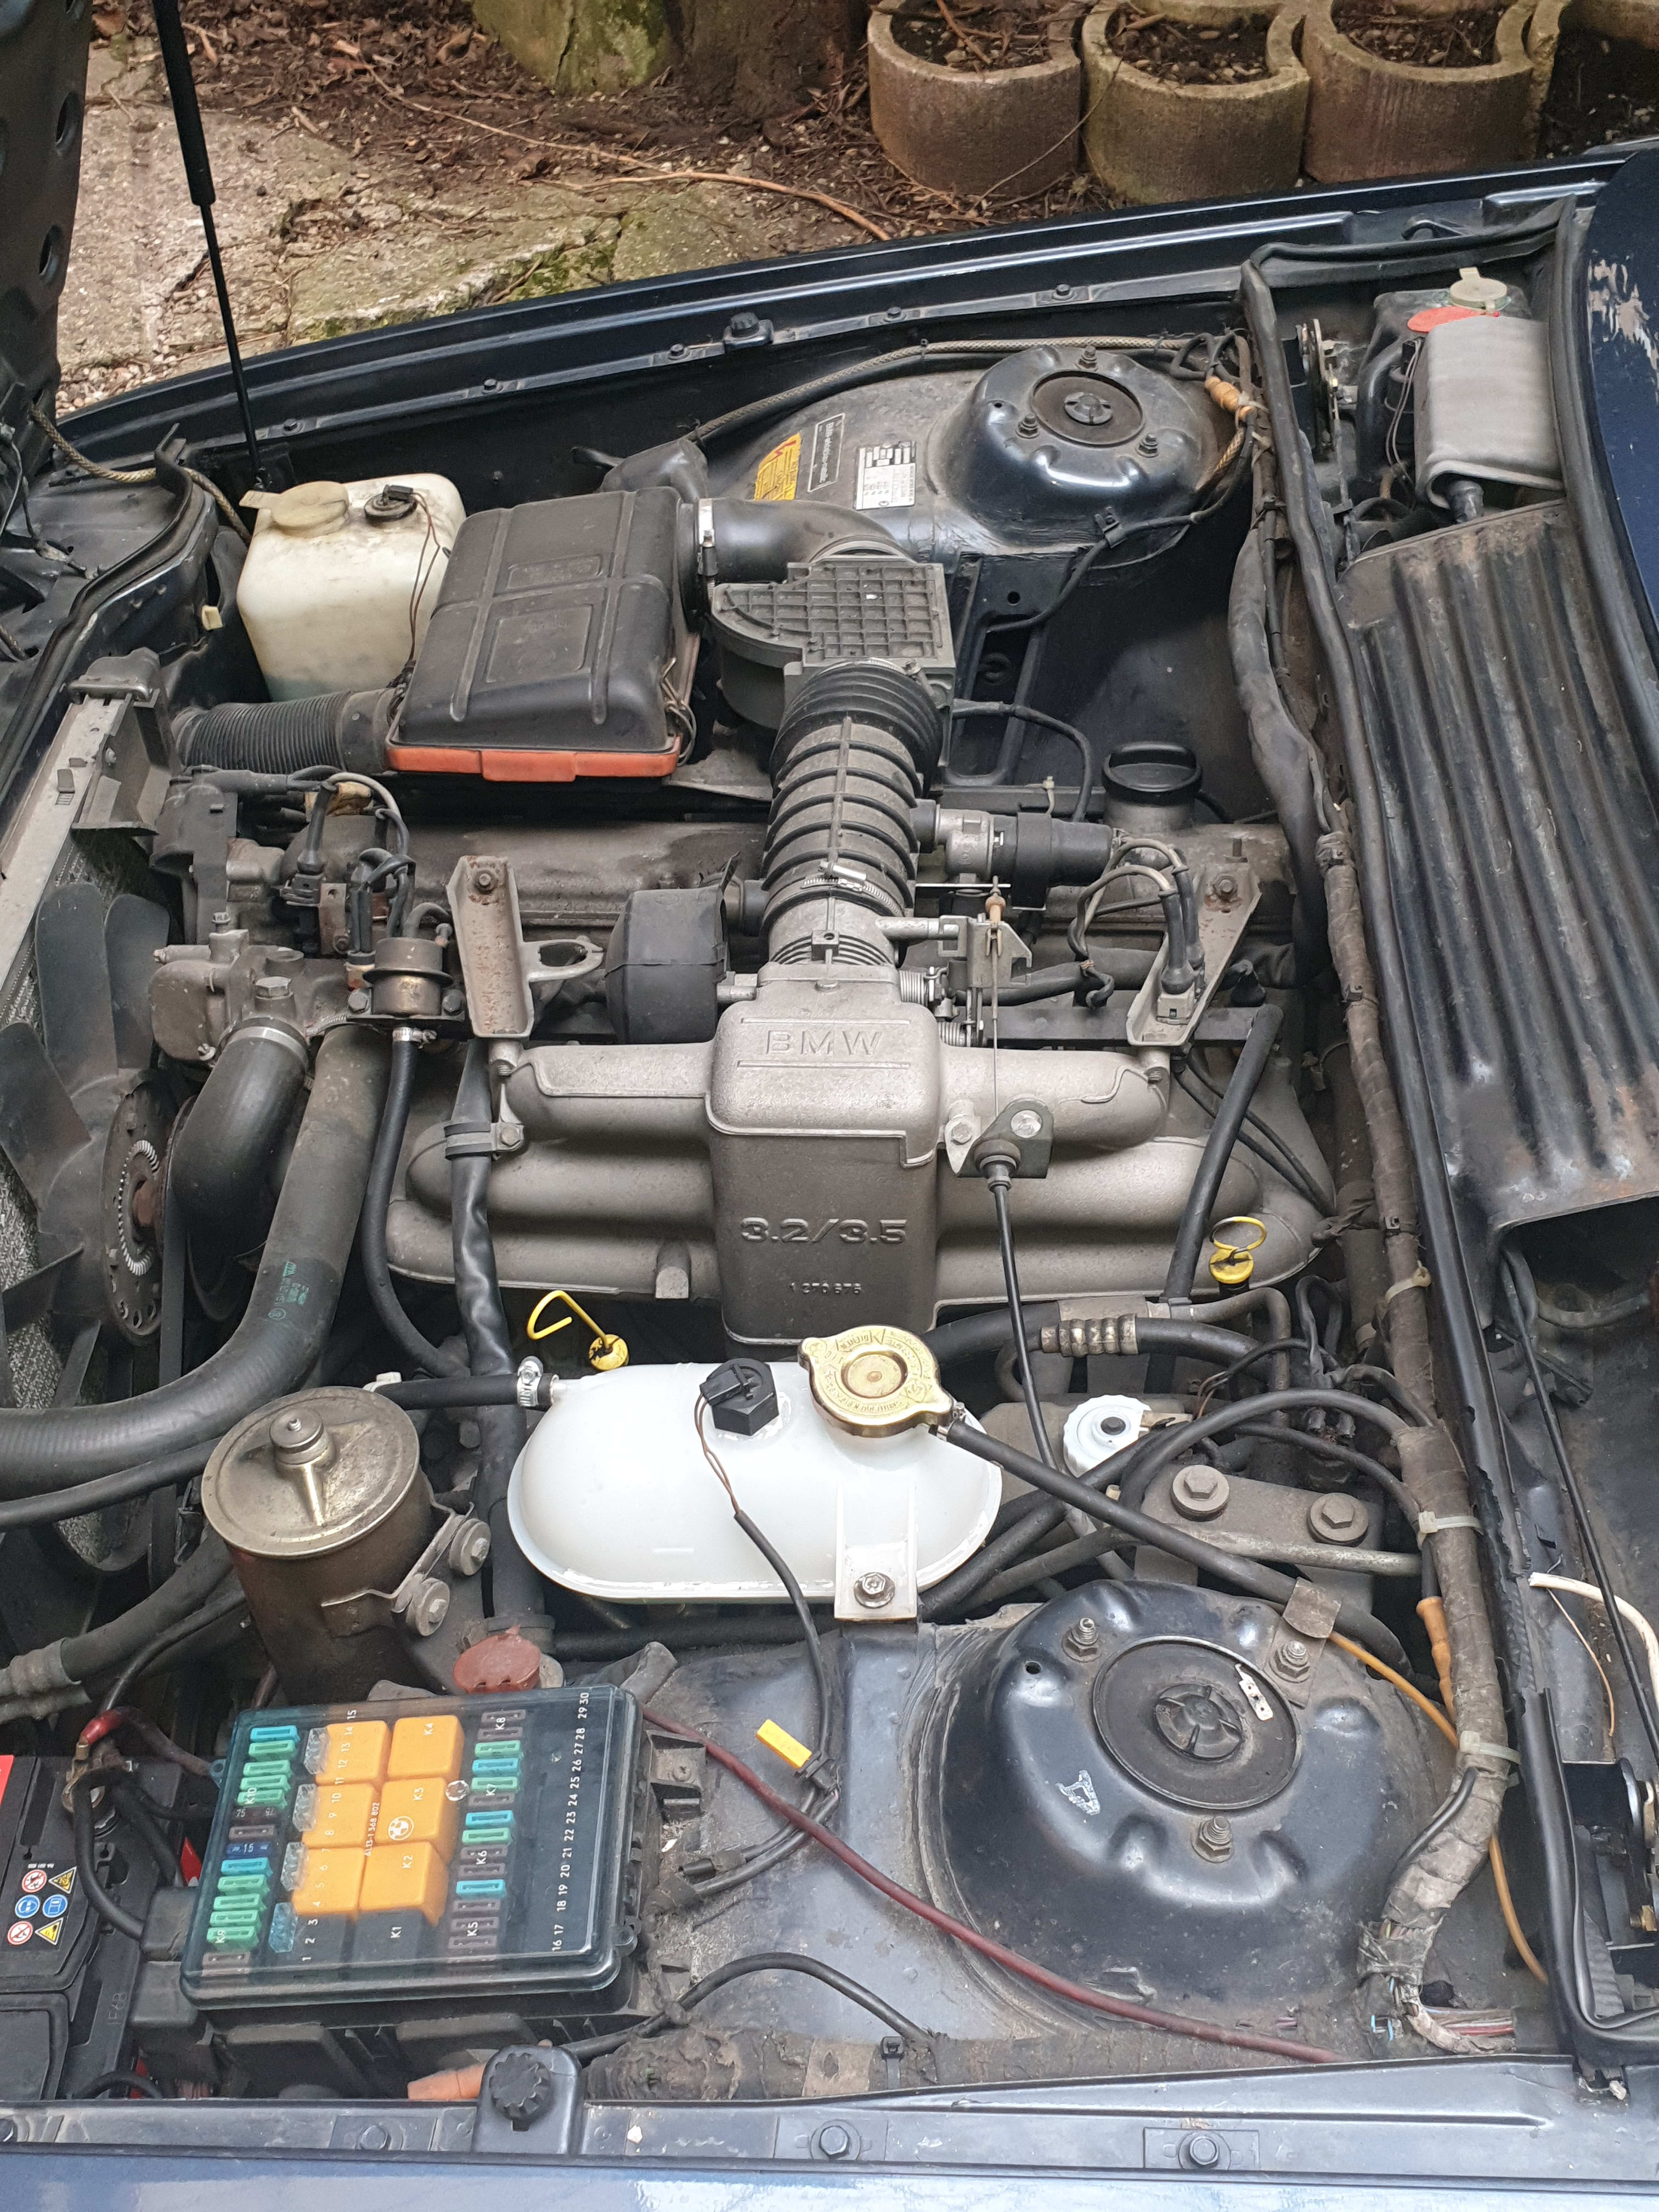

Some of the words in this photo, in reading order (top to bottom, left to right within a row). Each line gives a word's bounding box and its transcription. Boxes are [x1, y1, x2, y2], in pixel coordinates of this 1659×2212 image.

[765, 1029, 883, 1056] BMW
[741, 1217, 908, 1244] 3.2/3.5
[802, 1281, 830, 1295] 370
[579, 1692, 589, 1705] 30
[347, 1710, 357, 1719] 15
[578, 1707, 588, 1718] 29
[344, 1726, 353, 1735] 14
[575, 1728, 585, 1740] 28
[341, 1743, 350, 1752] 13
[574, 1743, 584, 1754] 27
[338, 1760, 348, 1769] 12
[572, 1759, 582, 1771] 26
[570, 1777, 580, 1788] 25
[245, 1787, 257, 1804] K10
[332, 1793, 341, 1802] 10
[568, 1794, 578, 1805] 24
[371, 1802, 380, 1815] 802
[566, 1812, 576, 1824] 23
[367, 1818, 376, 1831] 368
[467, 1922, 478, 1936] K5
[477, 1851, 487, 1864] K6
[486, 1785, 496, 1796] K7
[495, 1718, 506, 1730] K8
[391, 1927, 400, 1938] K1
[403, 1856, 413, 1868] K2
[414, 1787, 424, 1801] K3
[424, 1723, 434, 1735] K4
[564, 1829, 574, 1841] 22
[243, 1842, 255, 1853] 15
[562, 1848, 572, 1858] 21
[560, 1865, 571, 1877] 20
[558, 1884, 568, 1895] 19
[556, 1901, 566, 1912] 18
[554, 1925, 564, 1935] 17
[551, 1940, 562, 1951] 16
